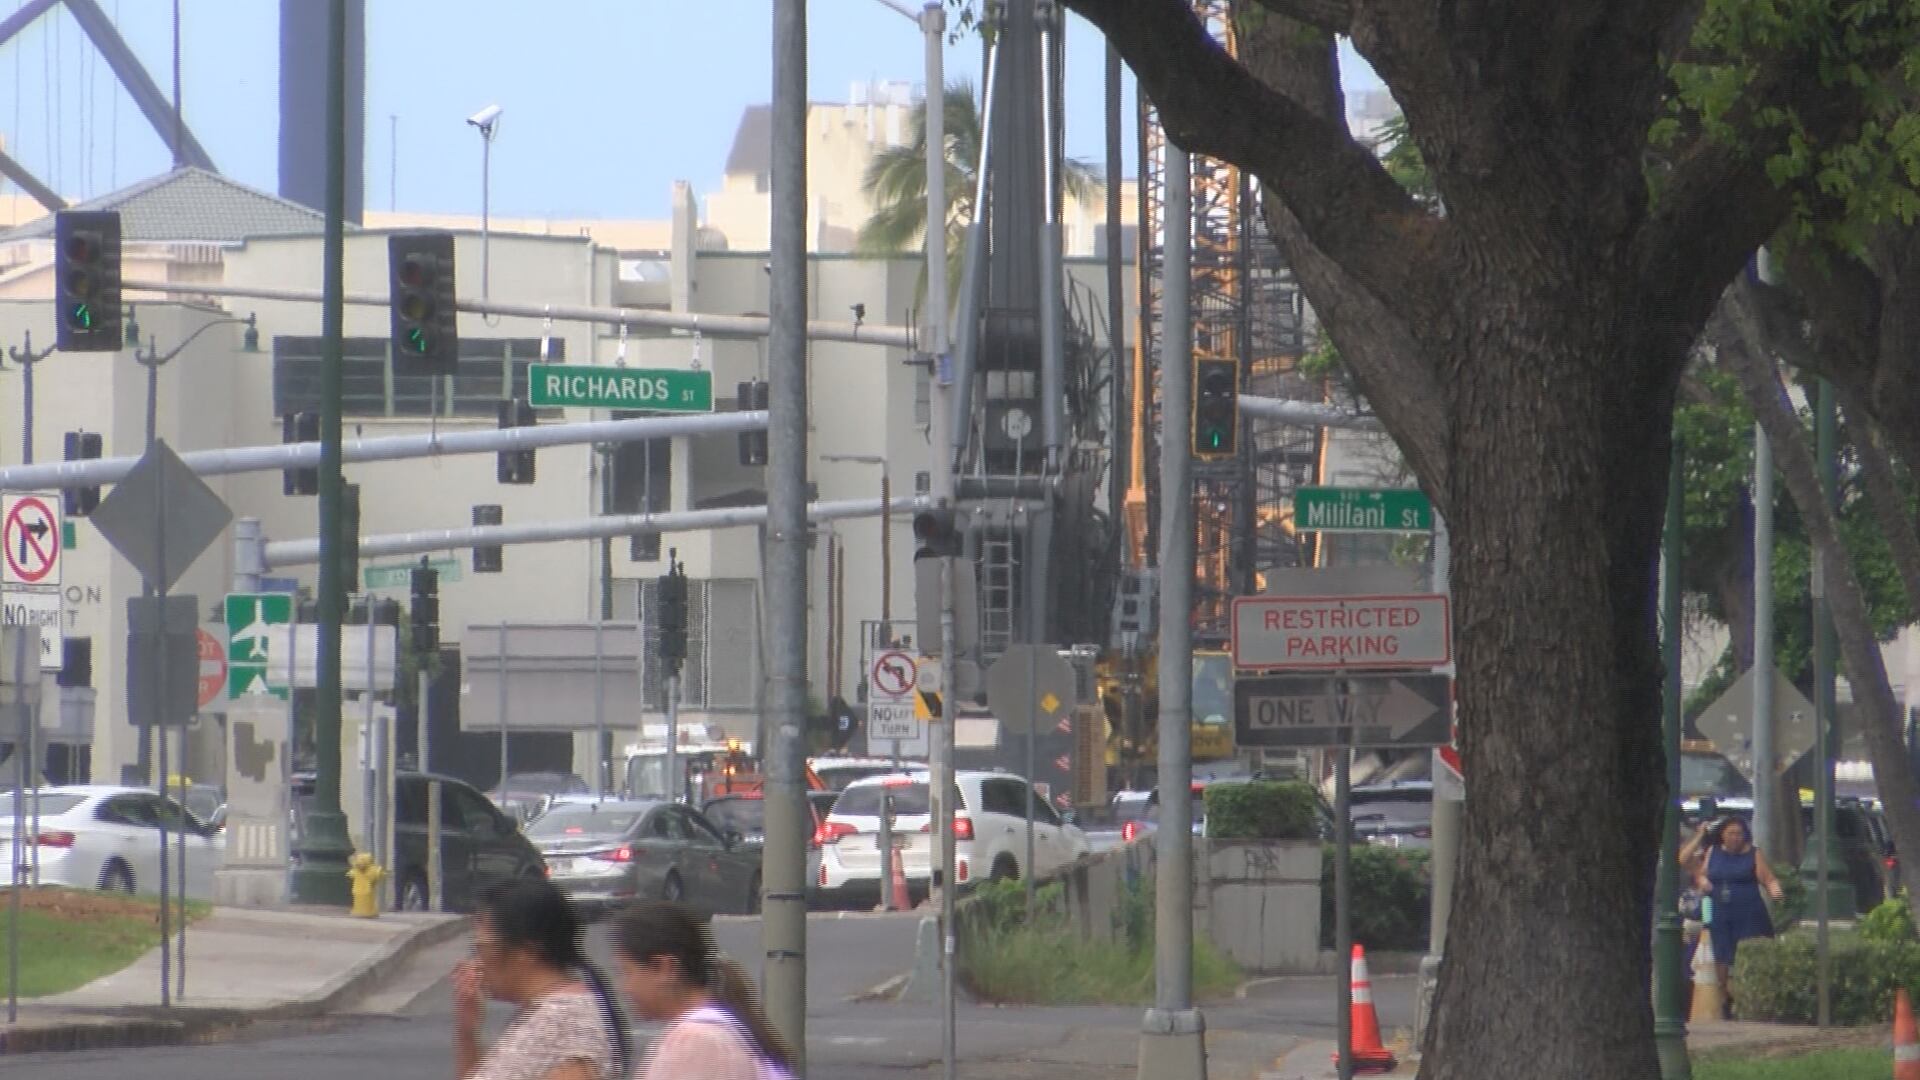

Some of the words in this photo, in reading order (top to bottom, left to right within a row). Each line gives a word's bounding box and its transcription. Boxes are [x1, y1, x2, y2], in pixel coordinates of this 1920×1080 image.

[546, 374, 669, 401] RICHARDS
[681, 389, 695, 402] ST
[1308, 500, 1385, 527] Mililani
[1402, 507, 1418, 527] St
[4, 603, 26, 627] NO
[1264, 607, 1420, 631] RESTRICTED
[1287, 634, 1399, 657] PARKING
[873, 707, 892, 721] NO
[1257, 698, 1315, 725] ONE
[1326, 695, 1382, 724] WAY
[881, 723, 910, 735] TURN
